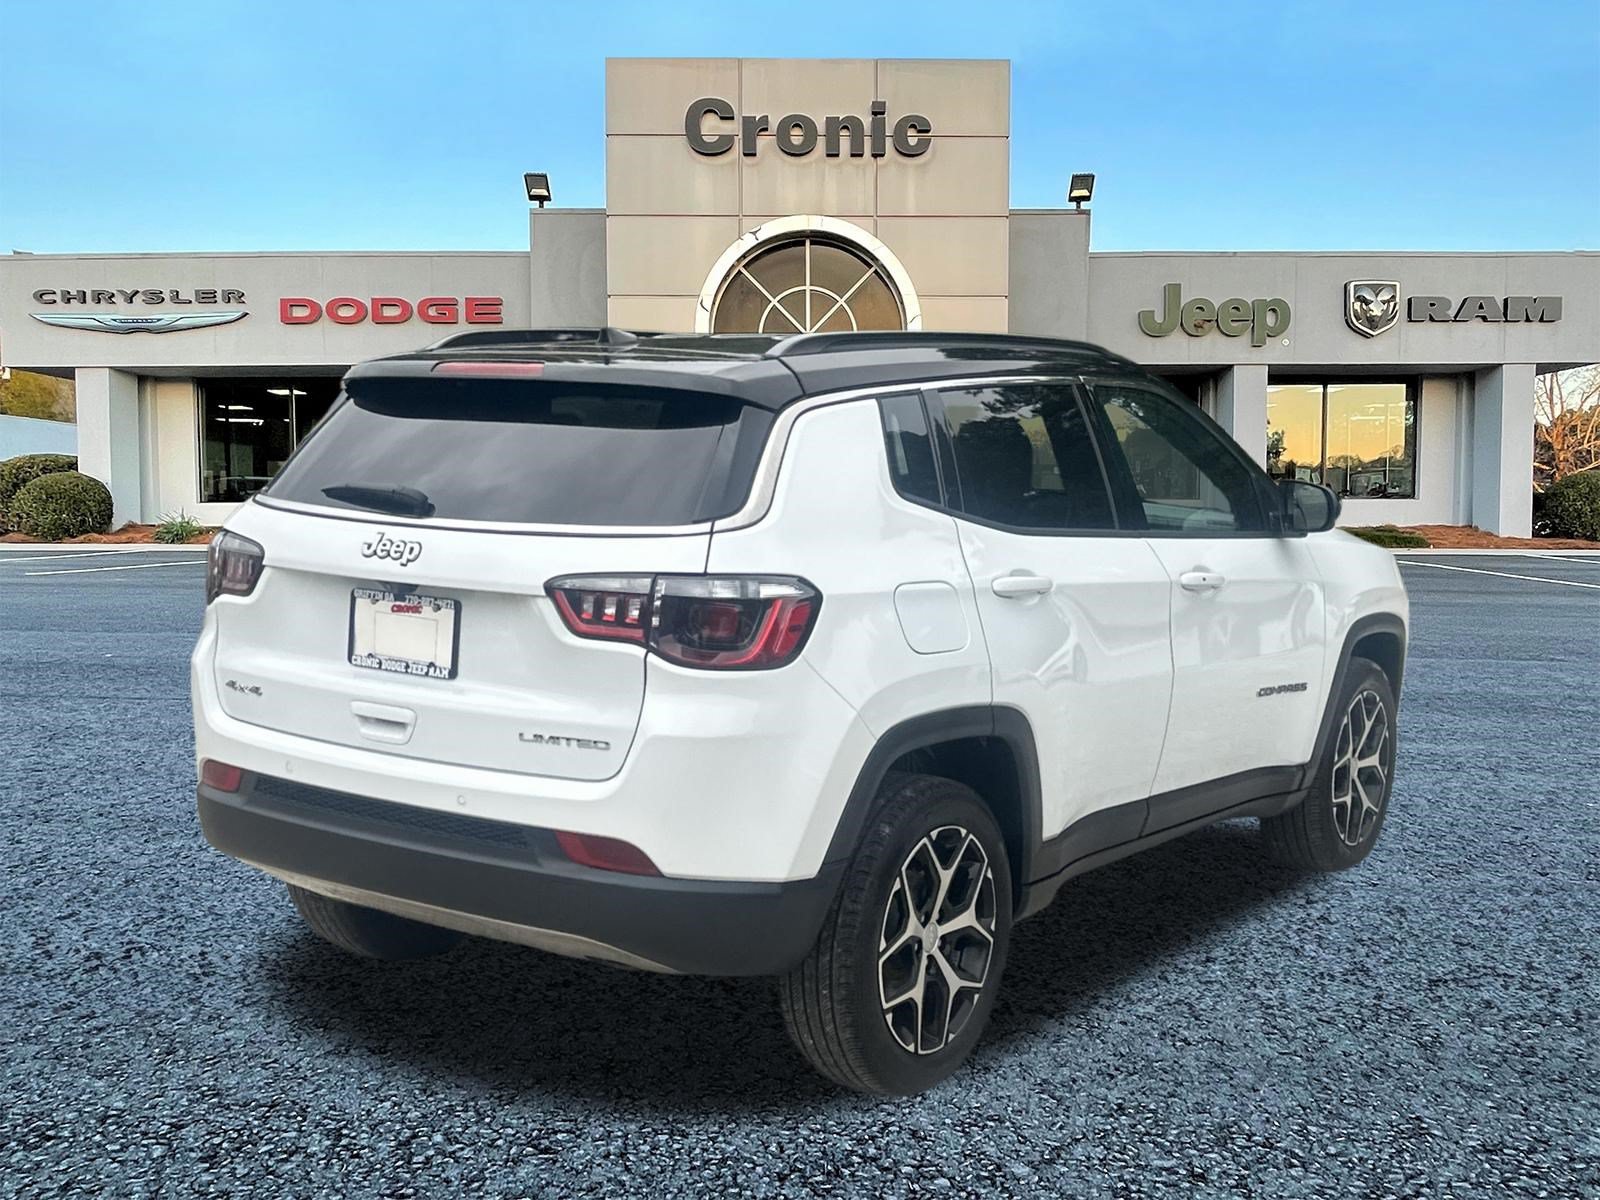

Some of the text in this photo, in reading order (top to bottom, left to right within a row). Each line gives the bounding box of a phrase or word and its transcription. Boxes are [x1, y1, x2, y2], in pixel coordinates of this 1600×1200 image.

[685, 98, 932, 157] Cronic
[32, 288, 246, 304] CHRYSLER
[280, 297, 503, 325] DODGE
[1138, 283, 1291, 347] Jeep
[1407, 296, 1563, 322] RAM
[361, 532, 422, 567] Jeep
[391, 603, 423, 614] CRONIC
[351, 655, 450, 679] CRONIC DODGE JEEP RAM
[1256, 682, 1308, 698] COMPASS
[519, 732, 611, 751] LIMITED
